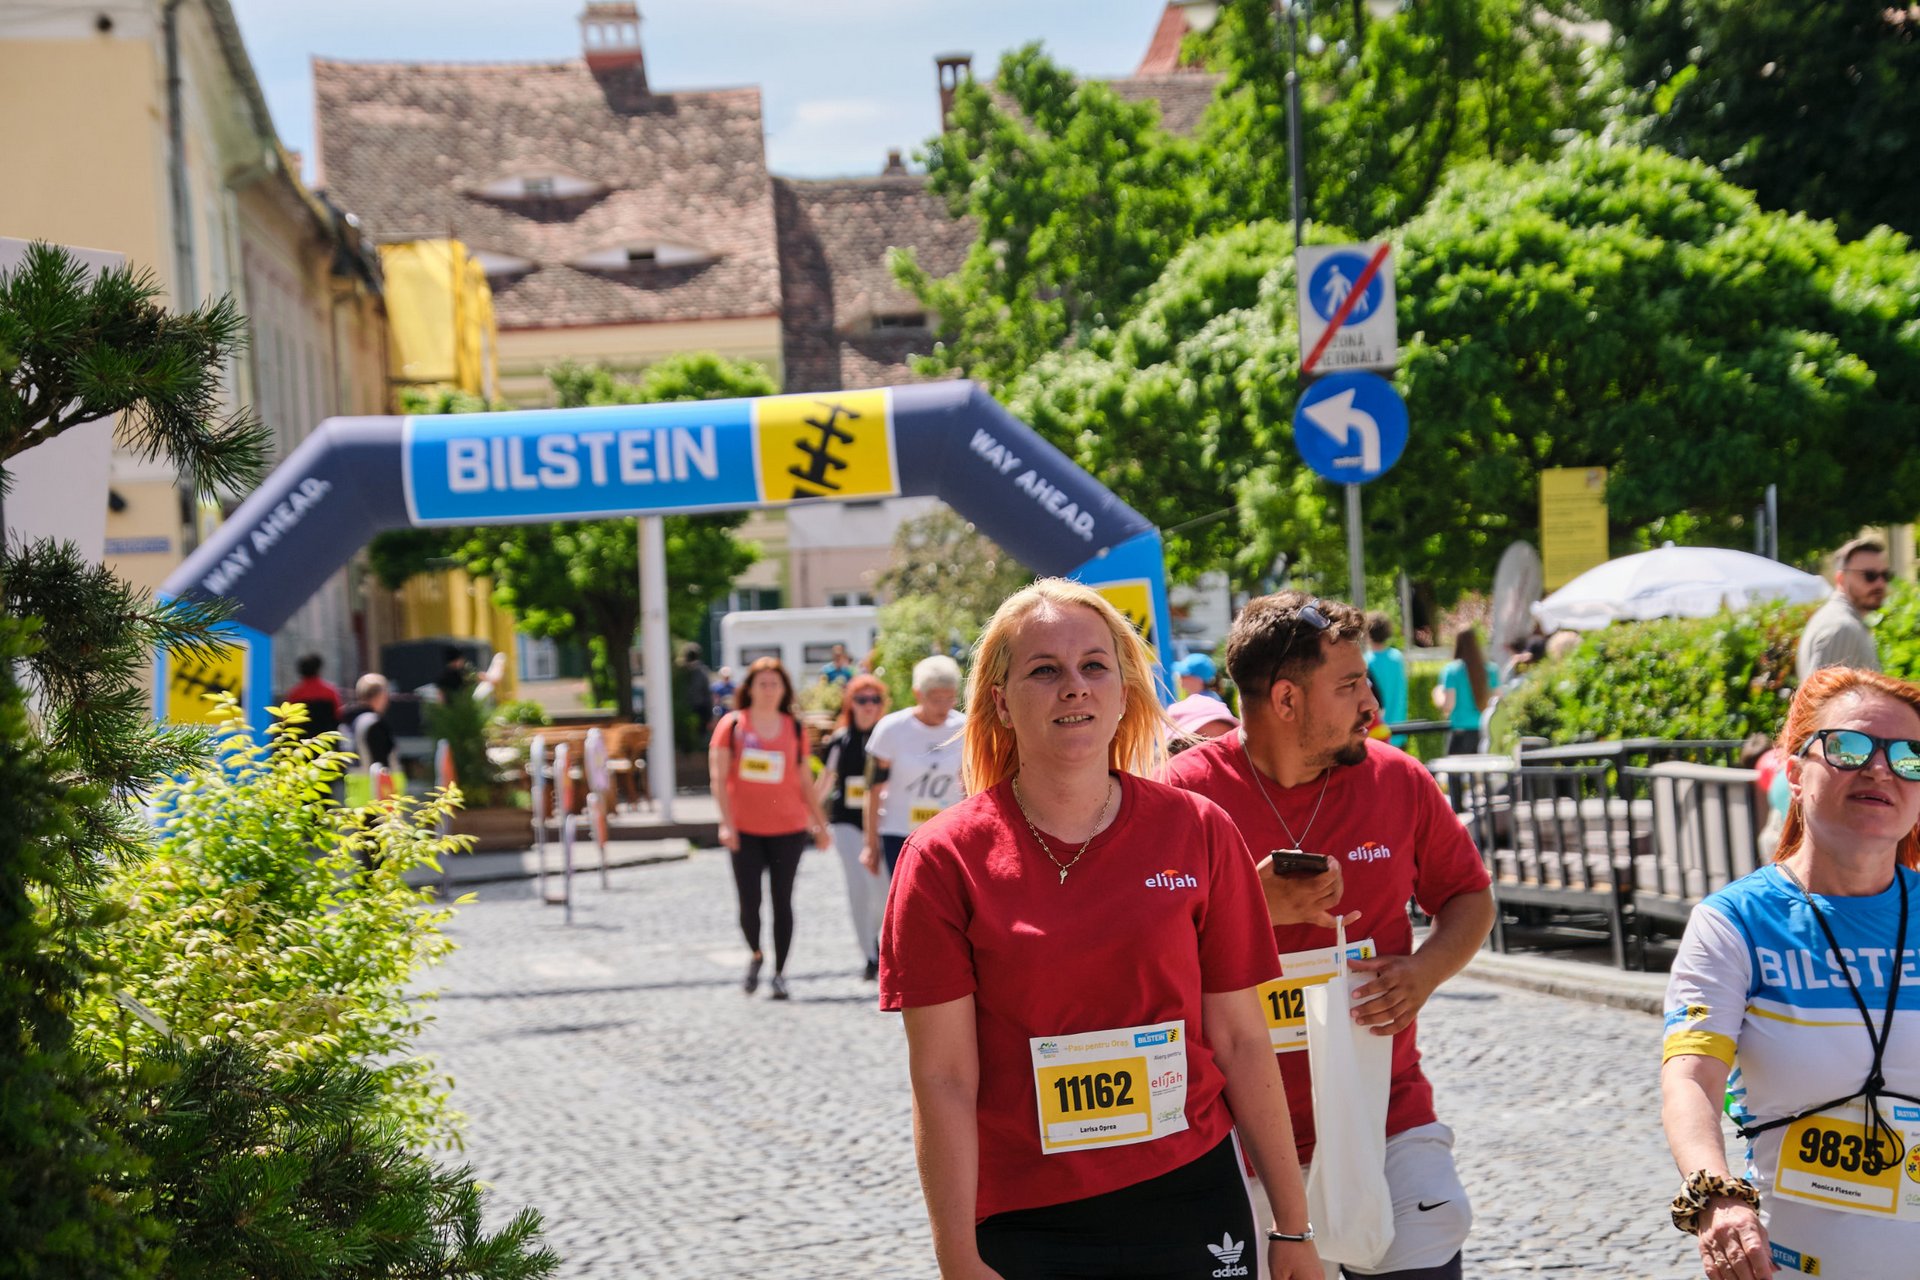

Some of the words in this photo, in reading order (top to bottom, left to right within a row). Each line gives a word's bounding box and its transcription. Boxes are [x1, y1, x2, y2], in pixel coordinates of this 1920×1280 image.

[446, 425, 720, 493] BILSTEIN
[969, 428, 1022, 475] WAY
[1015, 470, 1095, 542] AHEAD.
[201, 544, 254, 596] WAY
[250, 478, 333, 554] AHEAD.
[1347, 844, 1391, 863] elijah
[1144, 872, 1198, 891] elijah
[1755, 946, 1920, 990] BILSTE
[1151, 1072, 1183, 1088] elijah
[1054, 1071, 1134, 1113] 11162
[1080, 1124, 1098, 1133] Larisa
[1098, 1123, 1117, 1132] Oprea
[1799, 1127, 1885, 1176] 9835
[1811, 1181, 1834, 1192] Monica
[1772, 1248, 1797, 1264] STEIN
[1212, 1264, 1249, 1278] adidas
